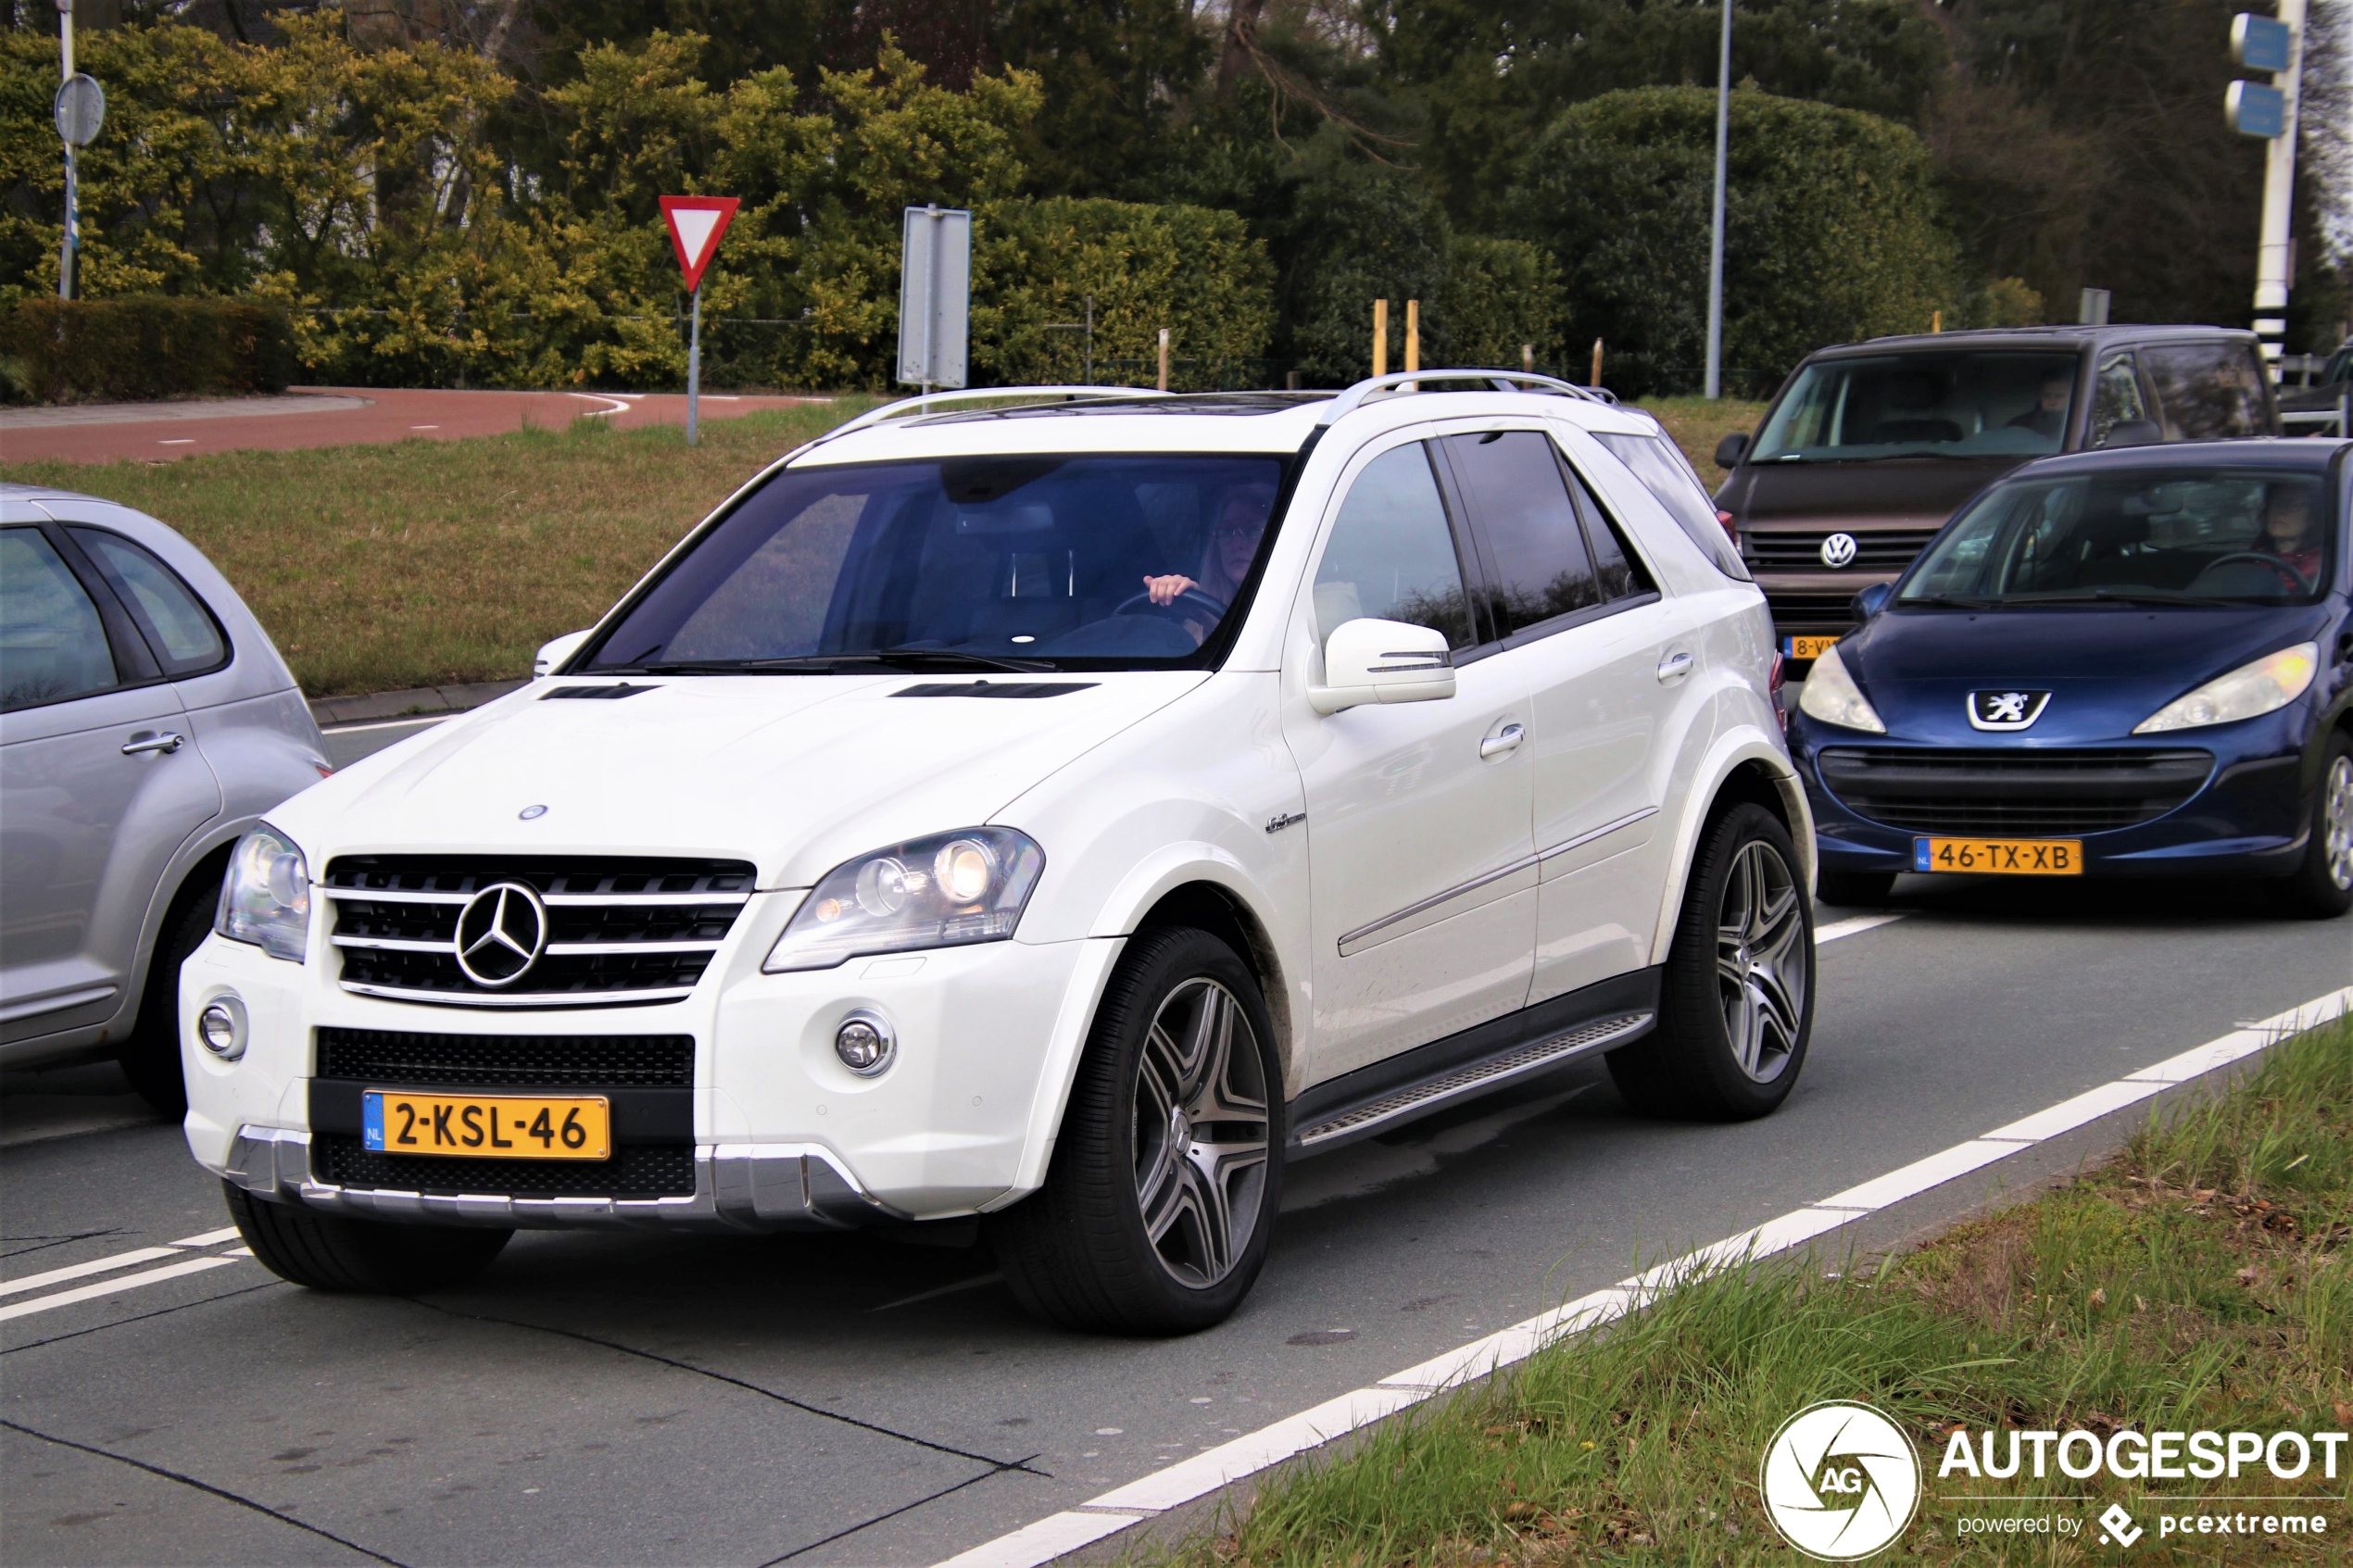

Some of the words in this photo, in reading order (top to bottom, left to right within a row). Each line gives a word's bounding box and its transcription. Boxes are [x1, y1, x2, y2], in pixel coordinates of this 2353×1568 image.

[1918, 856, 1929, 865] NL
[1939, 844, 2069, 869] 46-TX-XB
[367, 1128, 382, 1141] NL
[396, 1102, 586, 1149] 2-KSL-46
